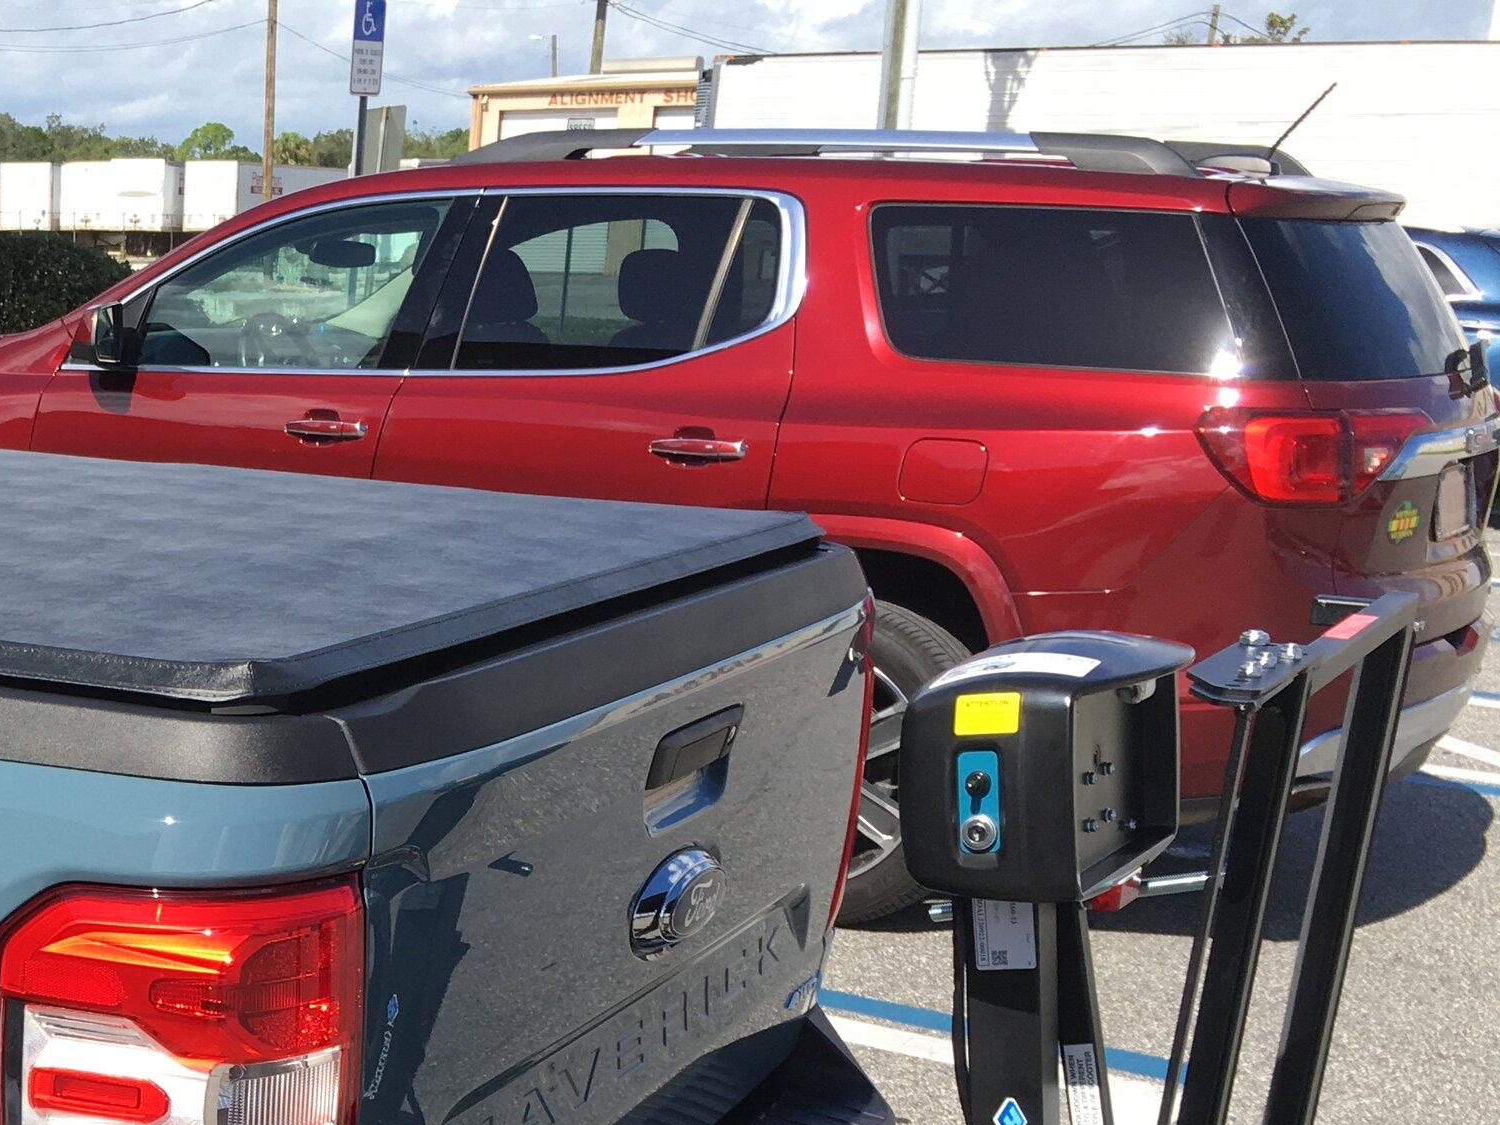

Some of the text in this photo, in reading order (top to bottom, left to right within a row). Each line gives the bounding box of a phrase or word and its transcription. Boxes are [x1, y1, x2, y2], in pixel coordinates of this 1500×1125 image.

[548, 88, 698, 106] ALIGNMENT SHO
[1068, 1054, 1077, 1080] WHEN
[1084, 1051, 1095, 1089] SCOOTER
